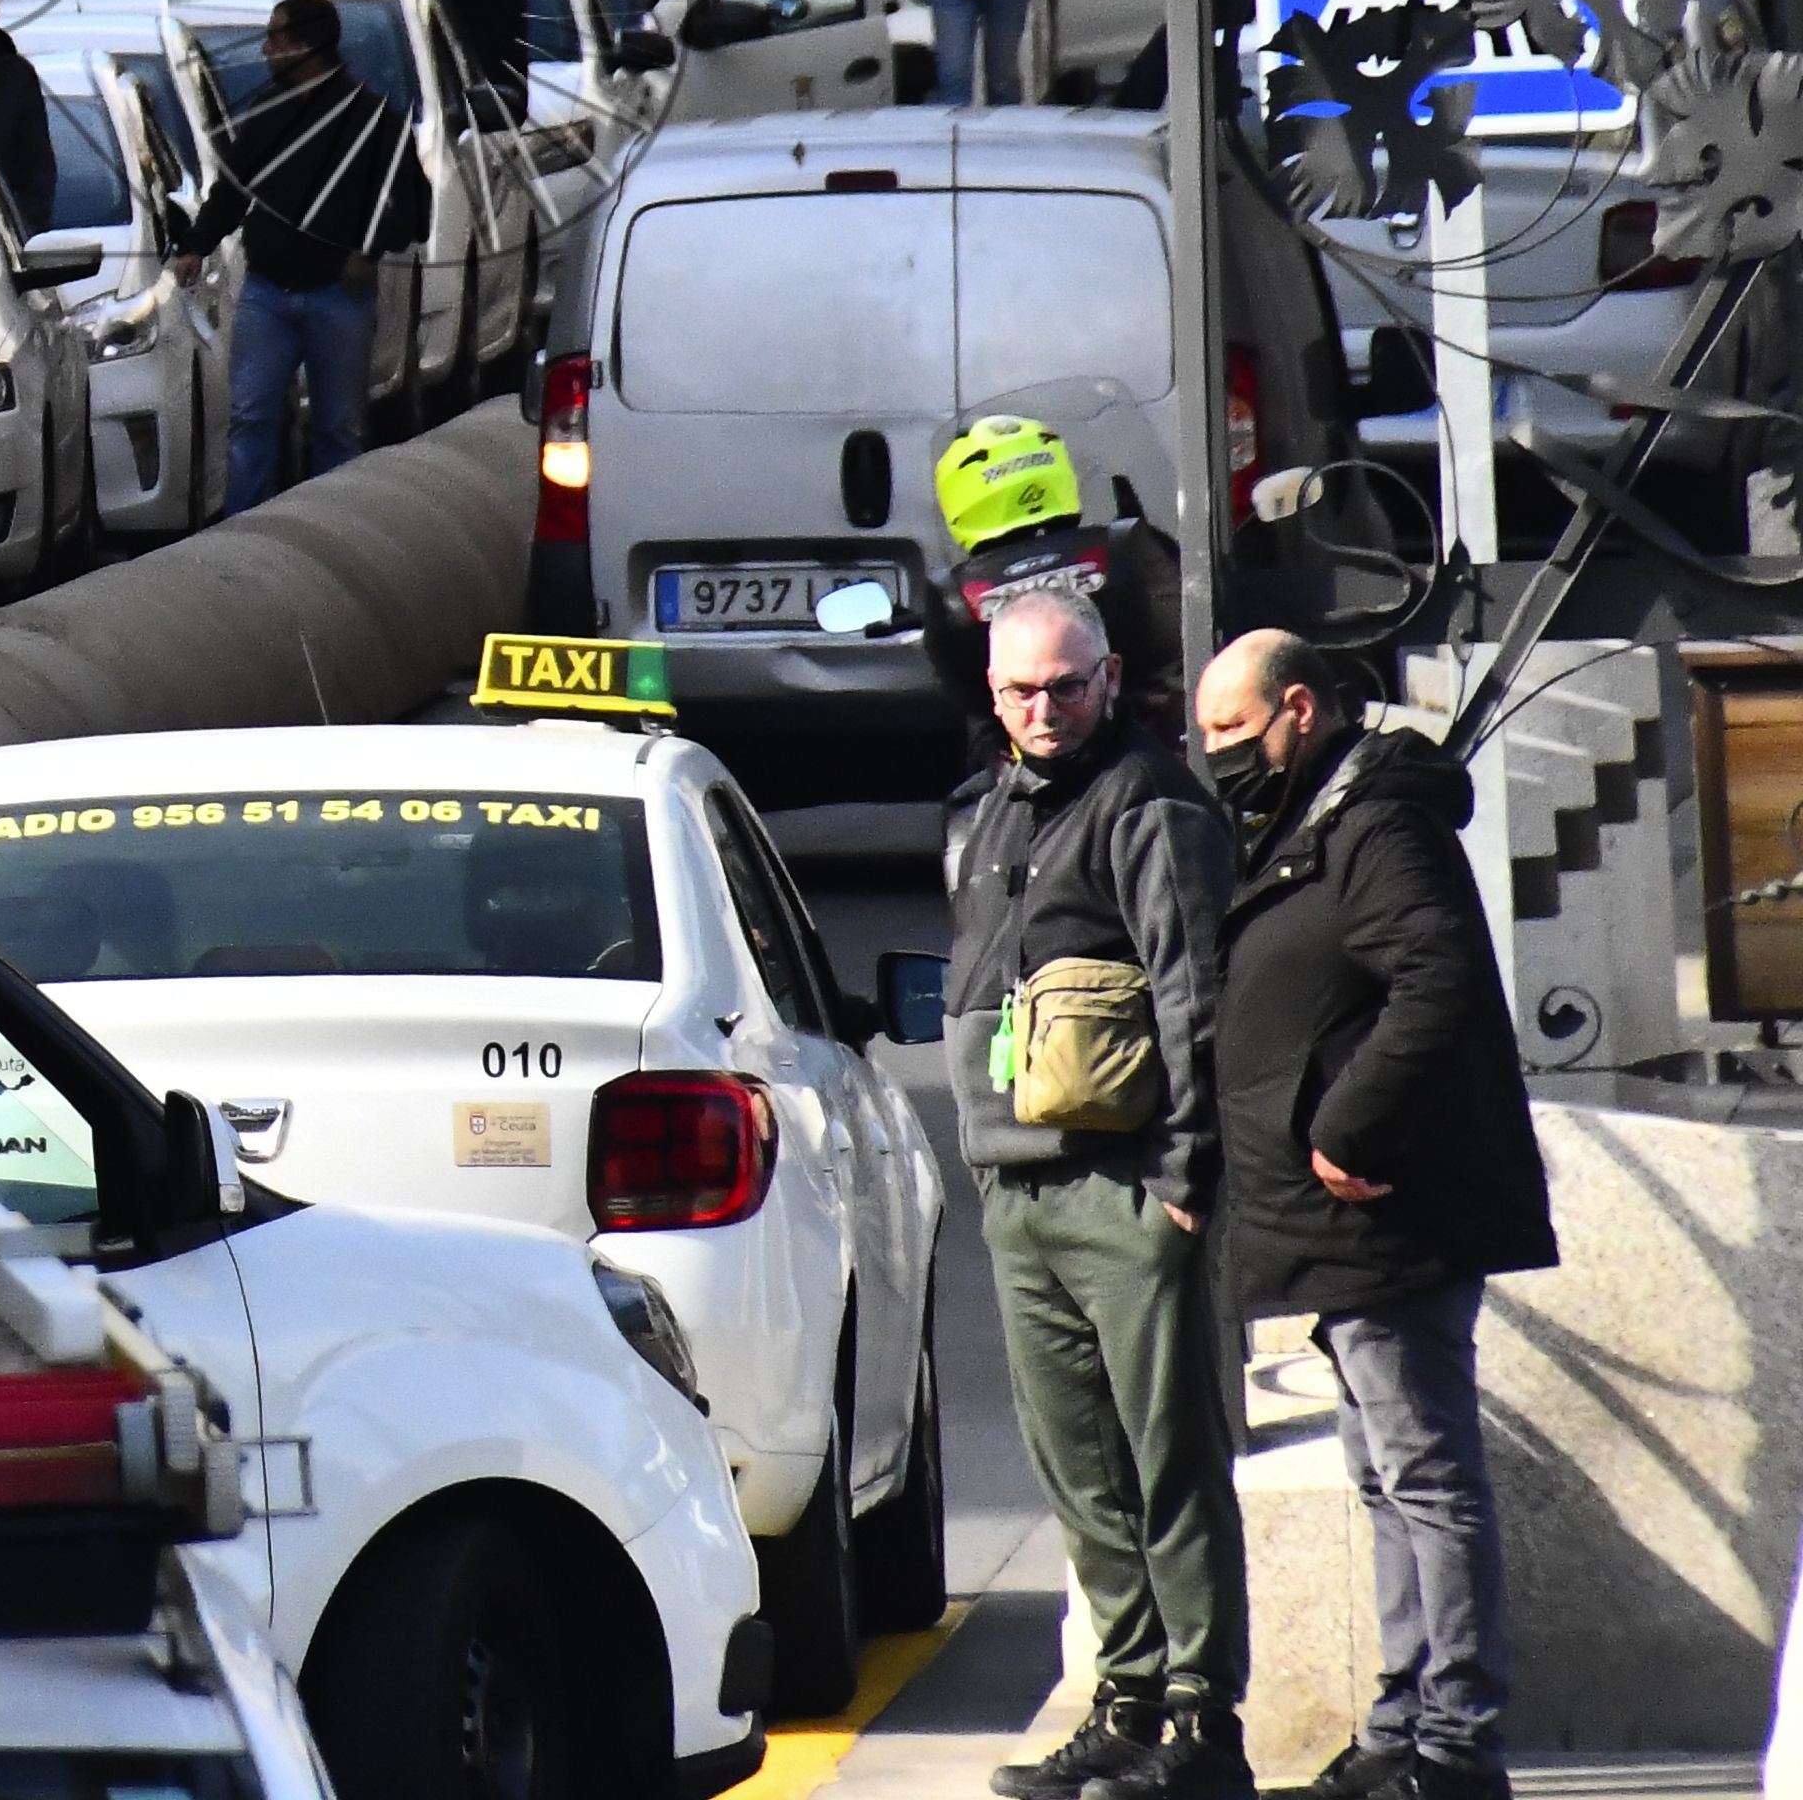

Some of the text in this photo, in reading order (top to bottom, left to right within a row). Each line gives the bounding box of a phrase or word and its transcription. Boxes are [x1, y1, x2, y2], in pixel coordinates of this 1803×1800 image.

[694, 578, 792, 615] 9737
[502, 647, 613, 690] TAXI
[132, 803, 224, 829] 956
[243, 800, 301, 824] 51
[320, 800, 383, 824] 54
[399, 800, 461, 826] 06
[478, 802, 601, 830] TAXI
[482, 1041, 563, 1079] 010
